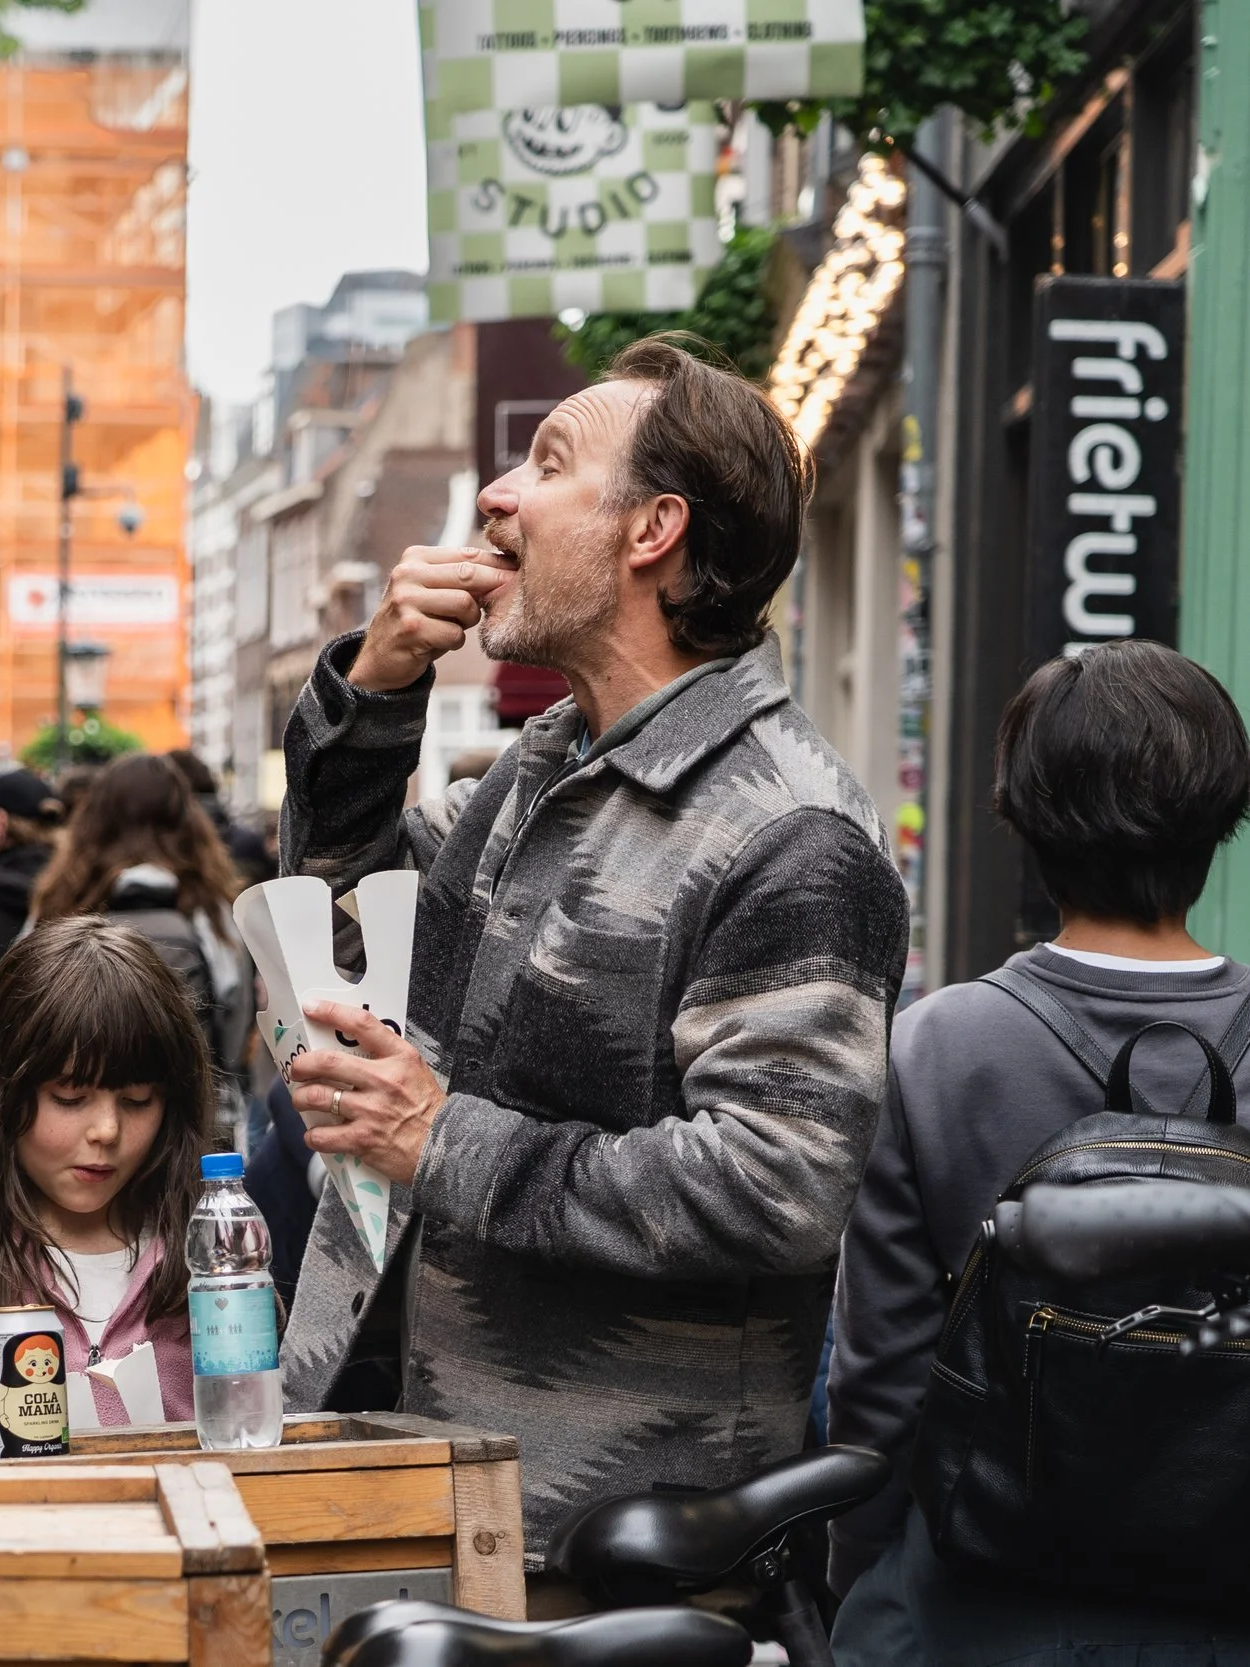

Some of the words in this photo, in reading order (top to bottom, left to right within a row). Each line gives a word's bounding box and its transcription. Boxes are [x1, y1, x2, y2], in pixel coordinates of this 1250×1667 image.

[476, 30, 536, 50] TATTOOS
[553, 27, 627, 47] PIERCINGS
[747, 21, 813, 41] CLOTHING
[472, 170, 659, 239] STUDIO
[1047, 318, 1170, 658] frietw
[24, 1392, 58, 1404] COLA
[18, 1403, 62, 1416] MAMA
[22, 1443, 43, 1454] Happy
